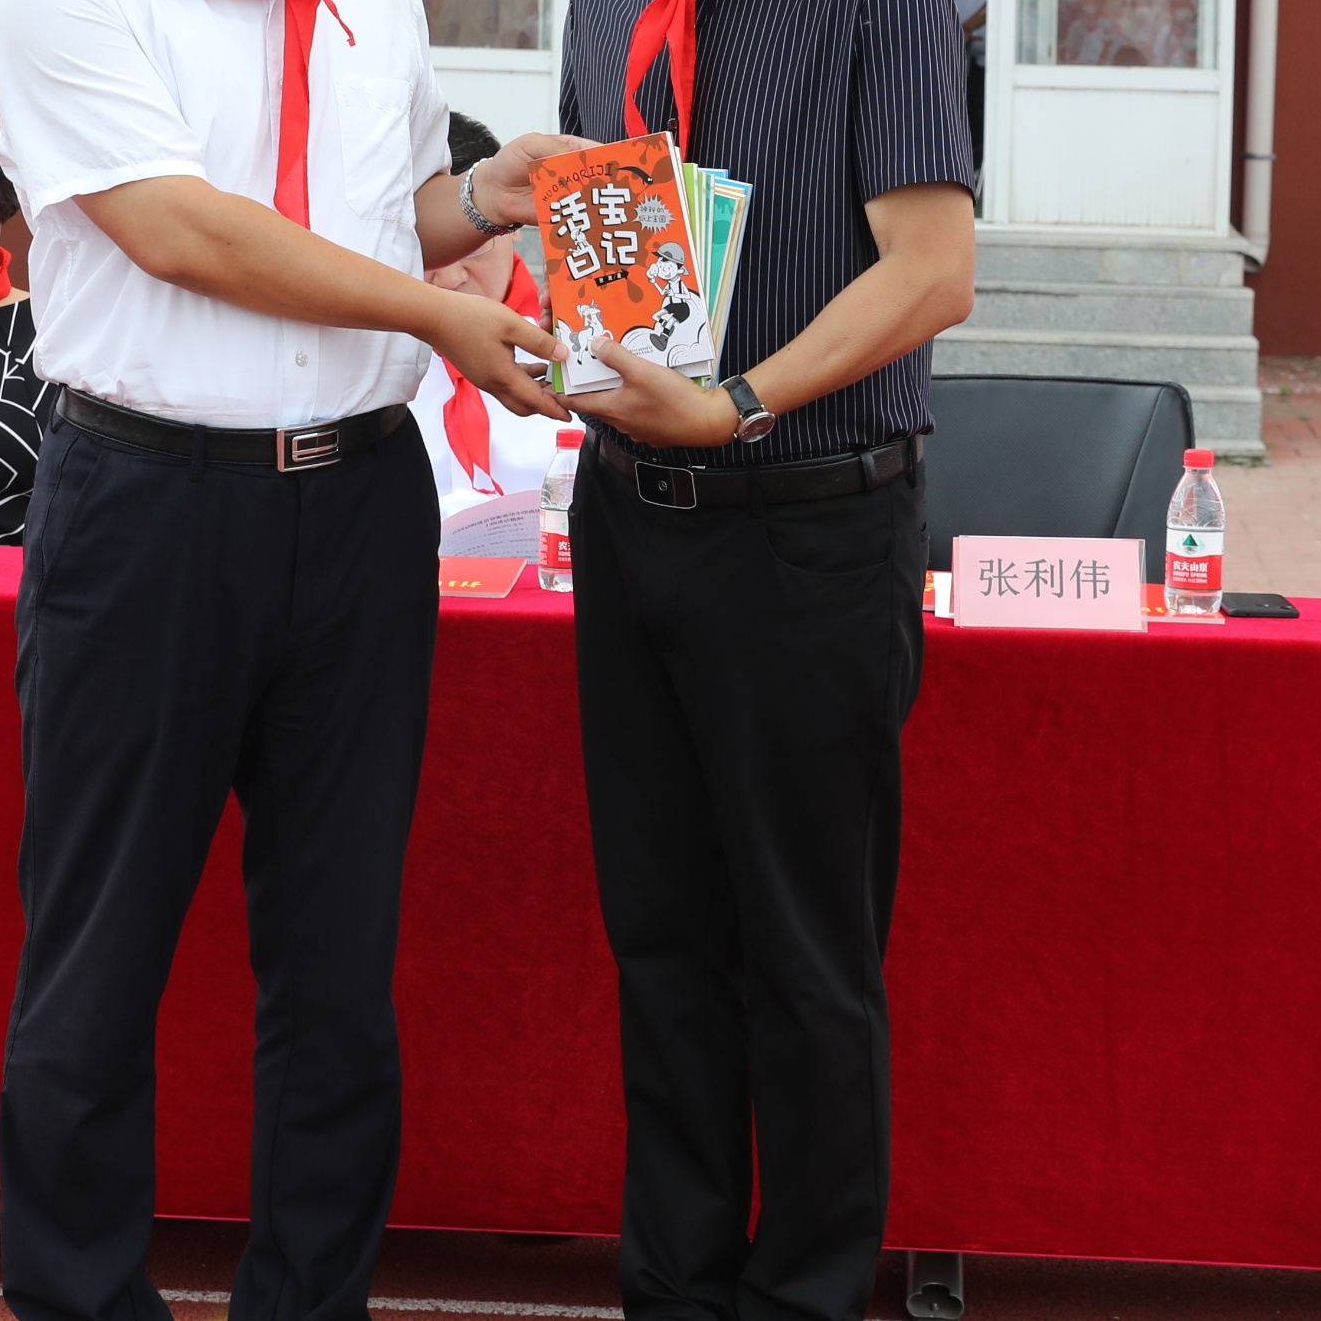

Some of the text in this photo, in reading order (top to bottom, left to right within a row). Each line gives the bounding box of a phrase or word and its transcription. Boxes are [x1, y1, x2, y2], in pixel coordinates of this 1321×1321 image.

[550, 182, 632, 236] 活宝
[565, 230, 639, 281] 日记
[978, 557, 1112, 600] 张利伟
[1173, 560, 1208, 572] 农夫山泉
